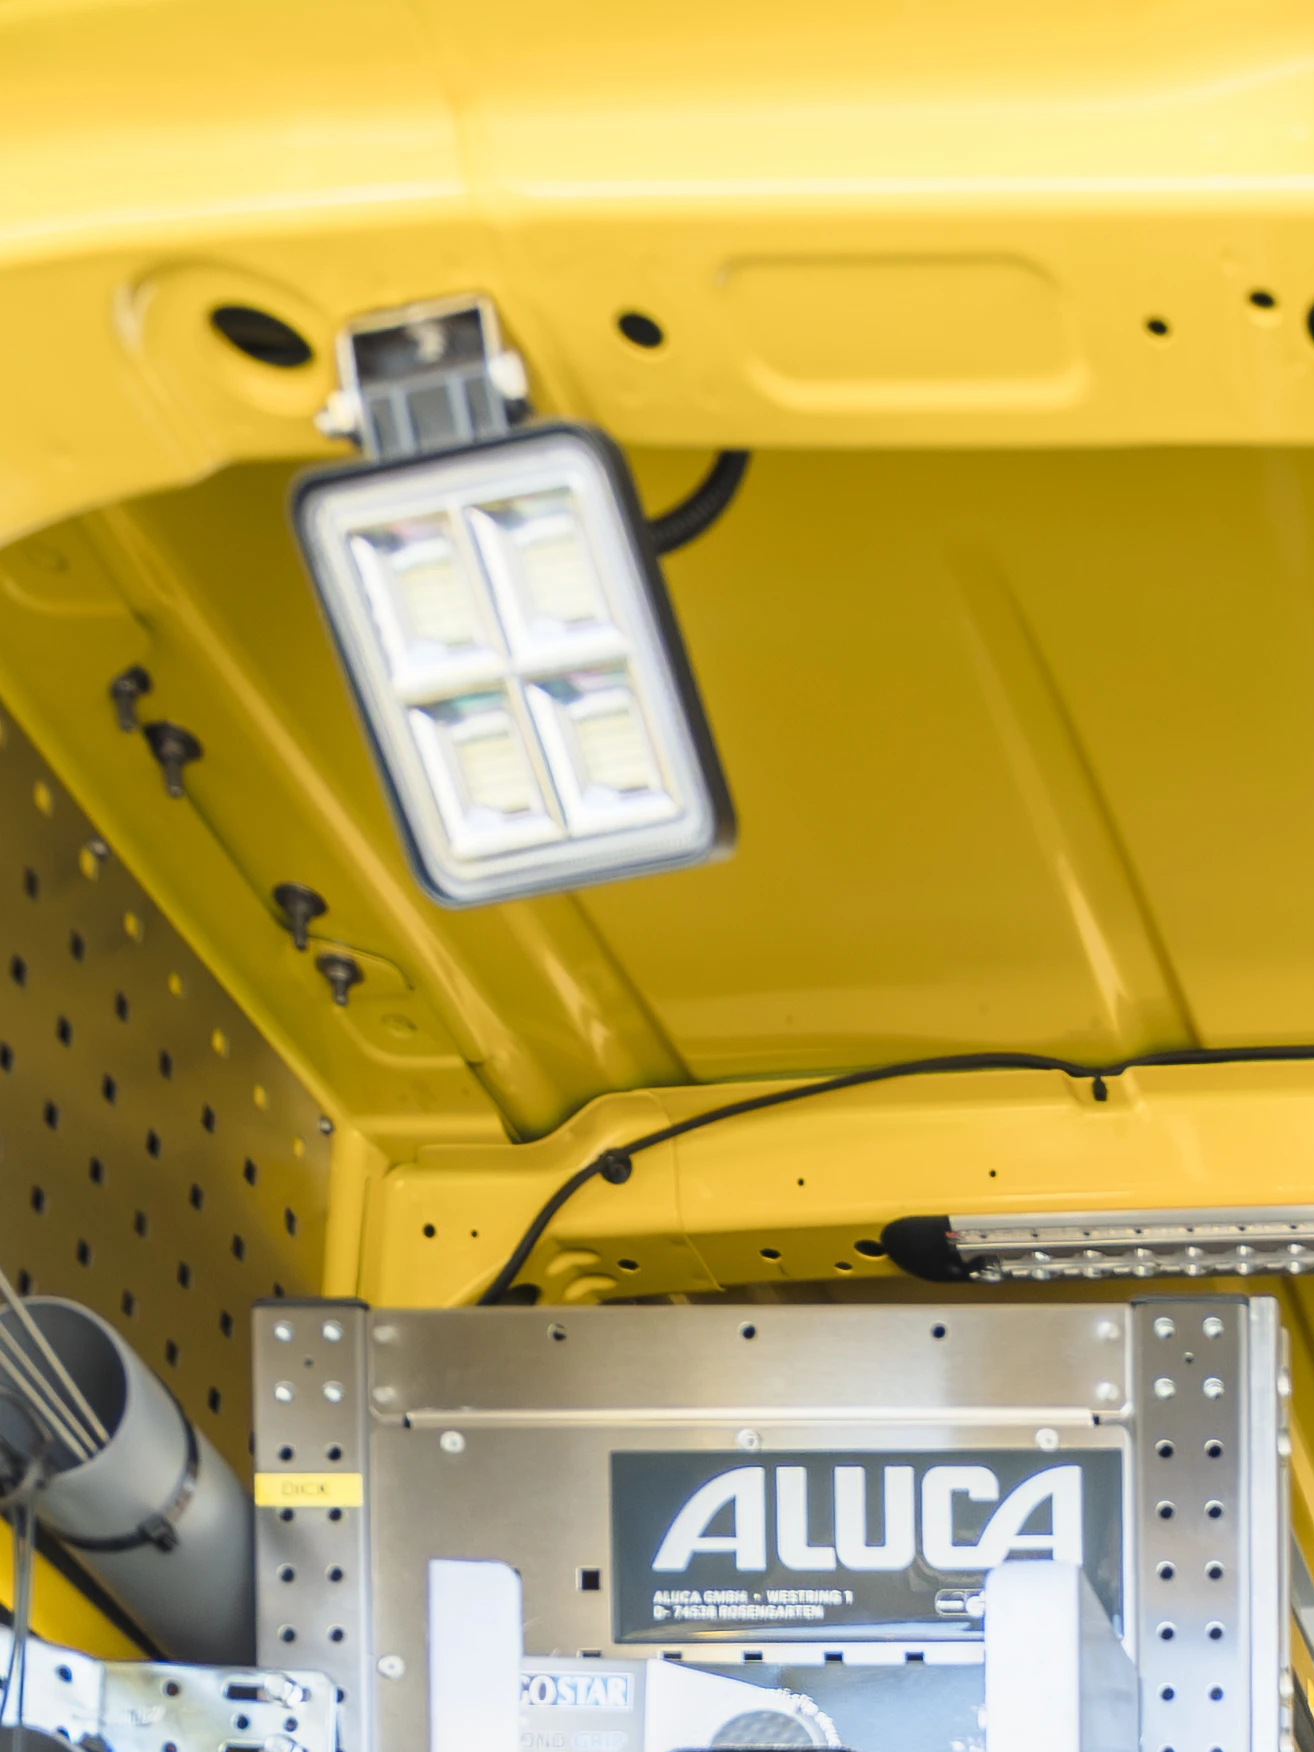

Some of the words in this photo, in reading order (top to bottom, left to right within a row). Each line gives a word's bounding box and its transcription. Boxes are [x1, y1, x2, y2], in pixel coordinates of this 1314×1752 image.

[652, 1465, 1083, 1571] ALUCA
[653, 1589, 702, 1605] ALUCA
[703, 1589, 748, 1605] GMBH
[766, 1589, 842, 1605] WESTRING
[718, 1605, 825, 1620] ROSENGARTEN
[520, 1673, 628, 1706] GOSTAR
